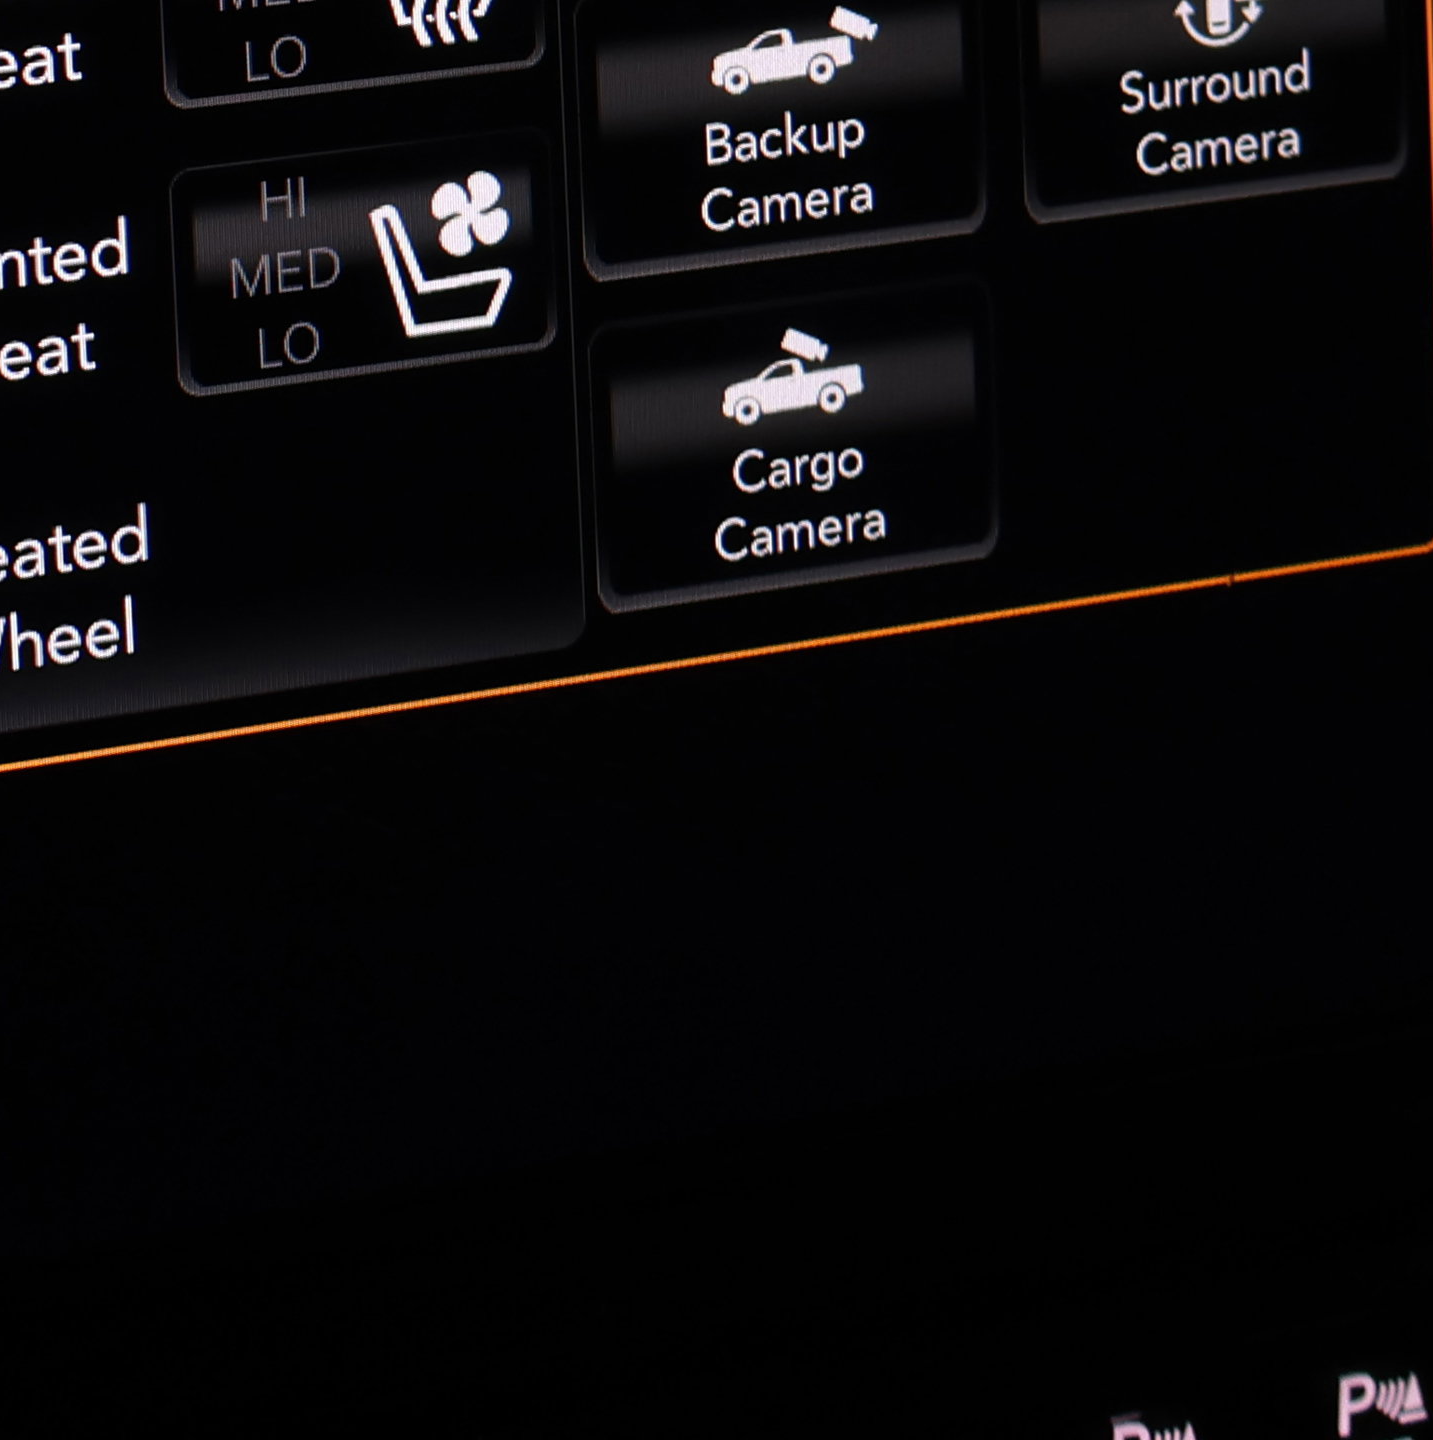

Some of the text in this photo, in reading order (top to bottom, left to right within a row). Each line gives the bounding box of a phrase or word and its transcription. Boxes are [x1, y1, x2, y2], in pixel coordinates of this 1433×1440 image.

[244, 35, 308, 82] LO
[1119, 48, 1313, 116] Surround
[704, 109, 866, 169] Backup
[1135, 123, 1303, 178] Camera
[259, 176, 308, 221] HI
[700, 177, 875, 234] Camera
[229, 247, 341, 301] MED
[256, 322, 321, 370] LO
[731, 444, 866, 500] Cargo
[714, 505, 888, 564] Camera
